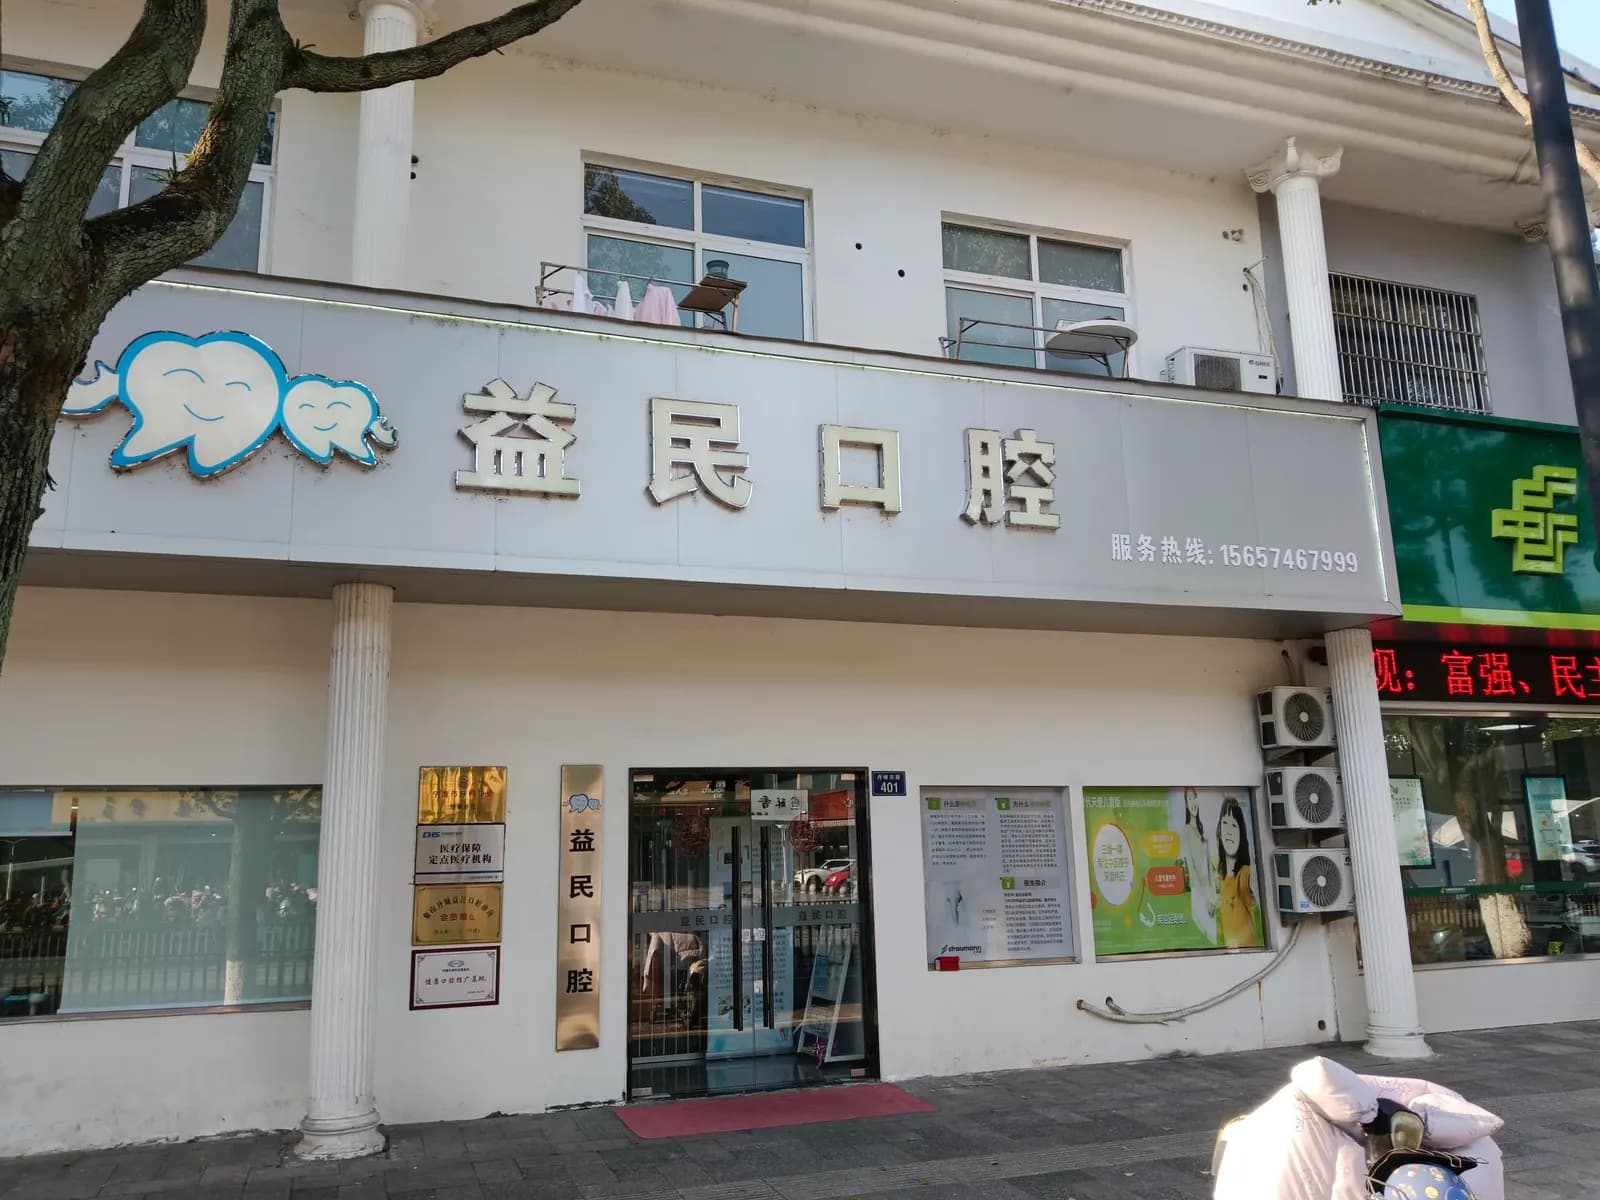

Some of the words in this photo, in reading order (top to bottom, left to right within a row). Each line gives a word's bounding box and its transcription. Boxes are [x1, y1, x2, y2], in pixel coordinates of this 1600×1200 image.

[455, 377, 1062, 531] 益民口腔
[880, 782, 898, 793] 401
[439, 843, 482, 854] 医疗保障
[428, 854, 492, 865] 定点医疗机构
[566, 829, 595, 993] 益民口腔
